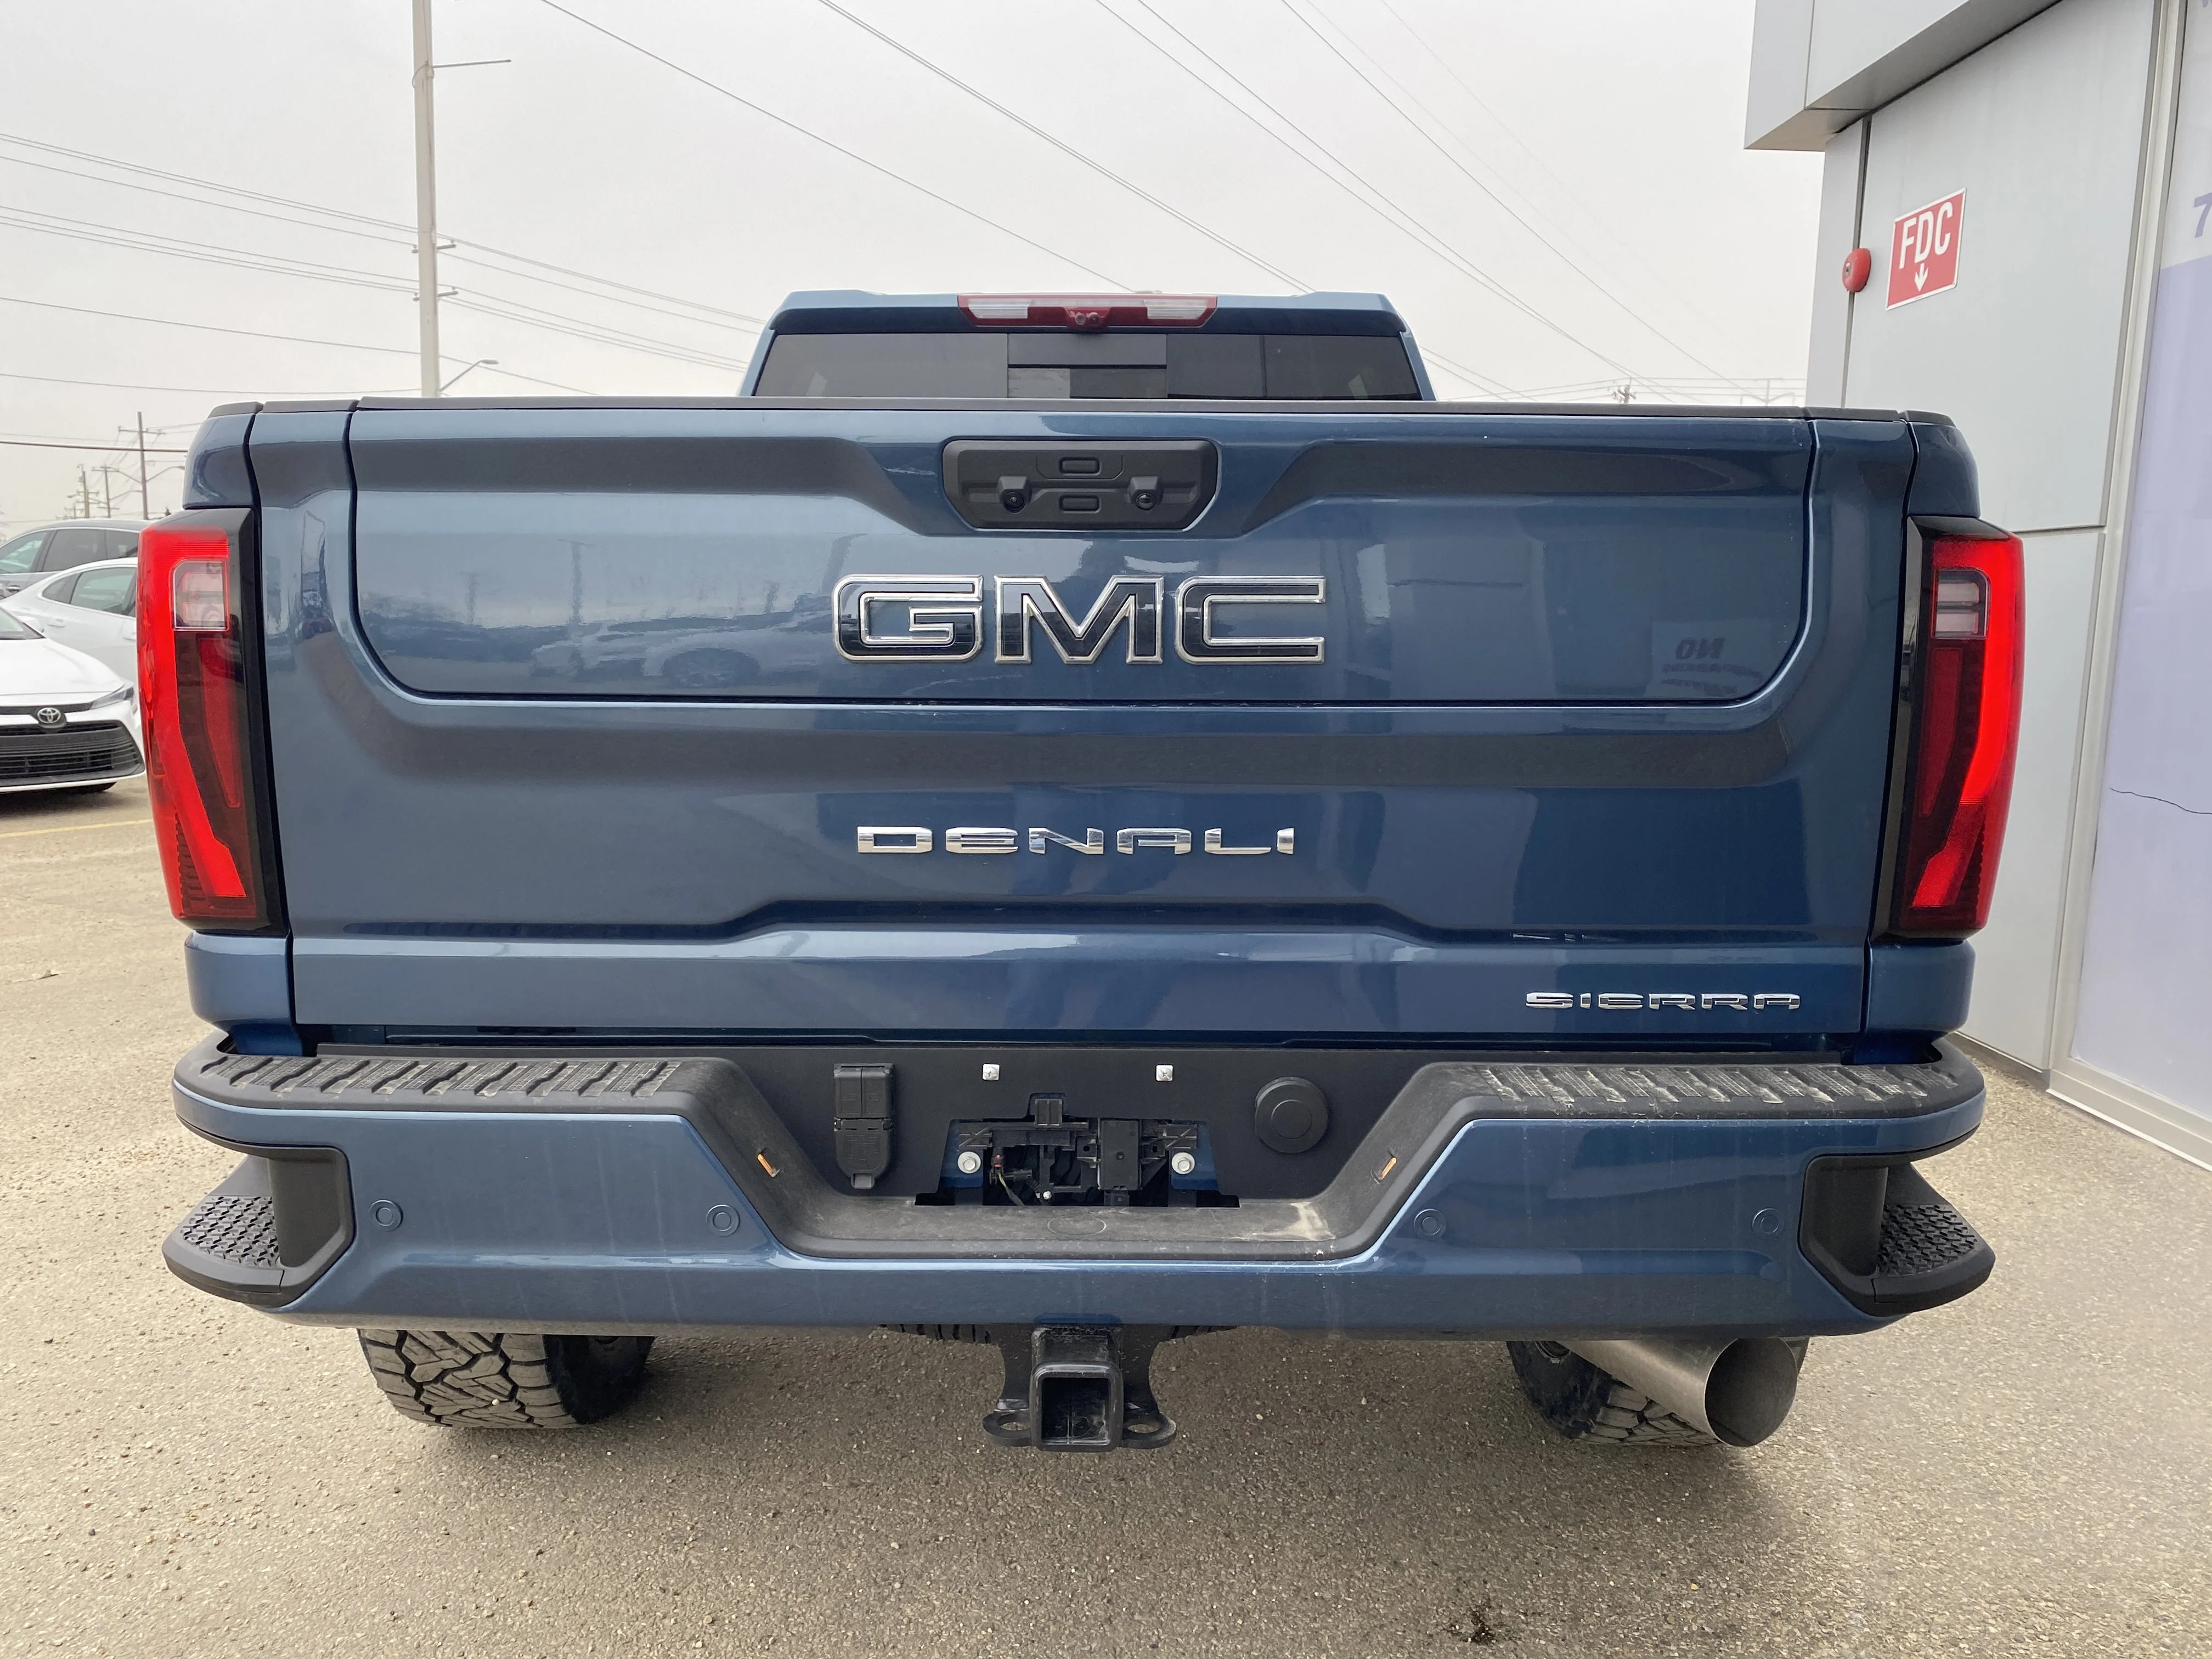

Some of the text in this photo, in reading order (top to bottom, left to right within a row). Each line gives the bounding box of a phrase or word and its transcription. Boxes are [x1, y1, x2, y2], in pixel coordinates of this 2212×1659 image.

[1899, 201, 1954, 269] FDC
[832, 574, 1327, 664] GMC
[857, 826, 1295, 855] DENALI
[1525, 992, 1801, 1010] SIERRA
